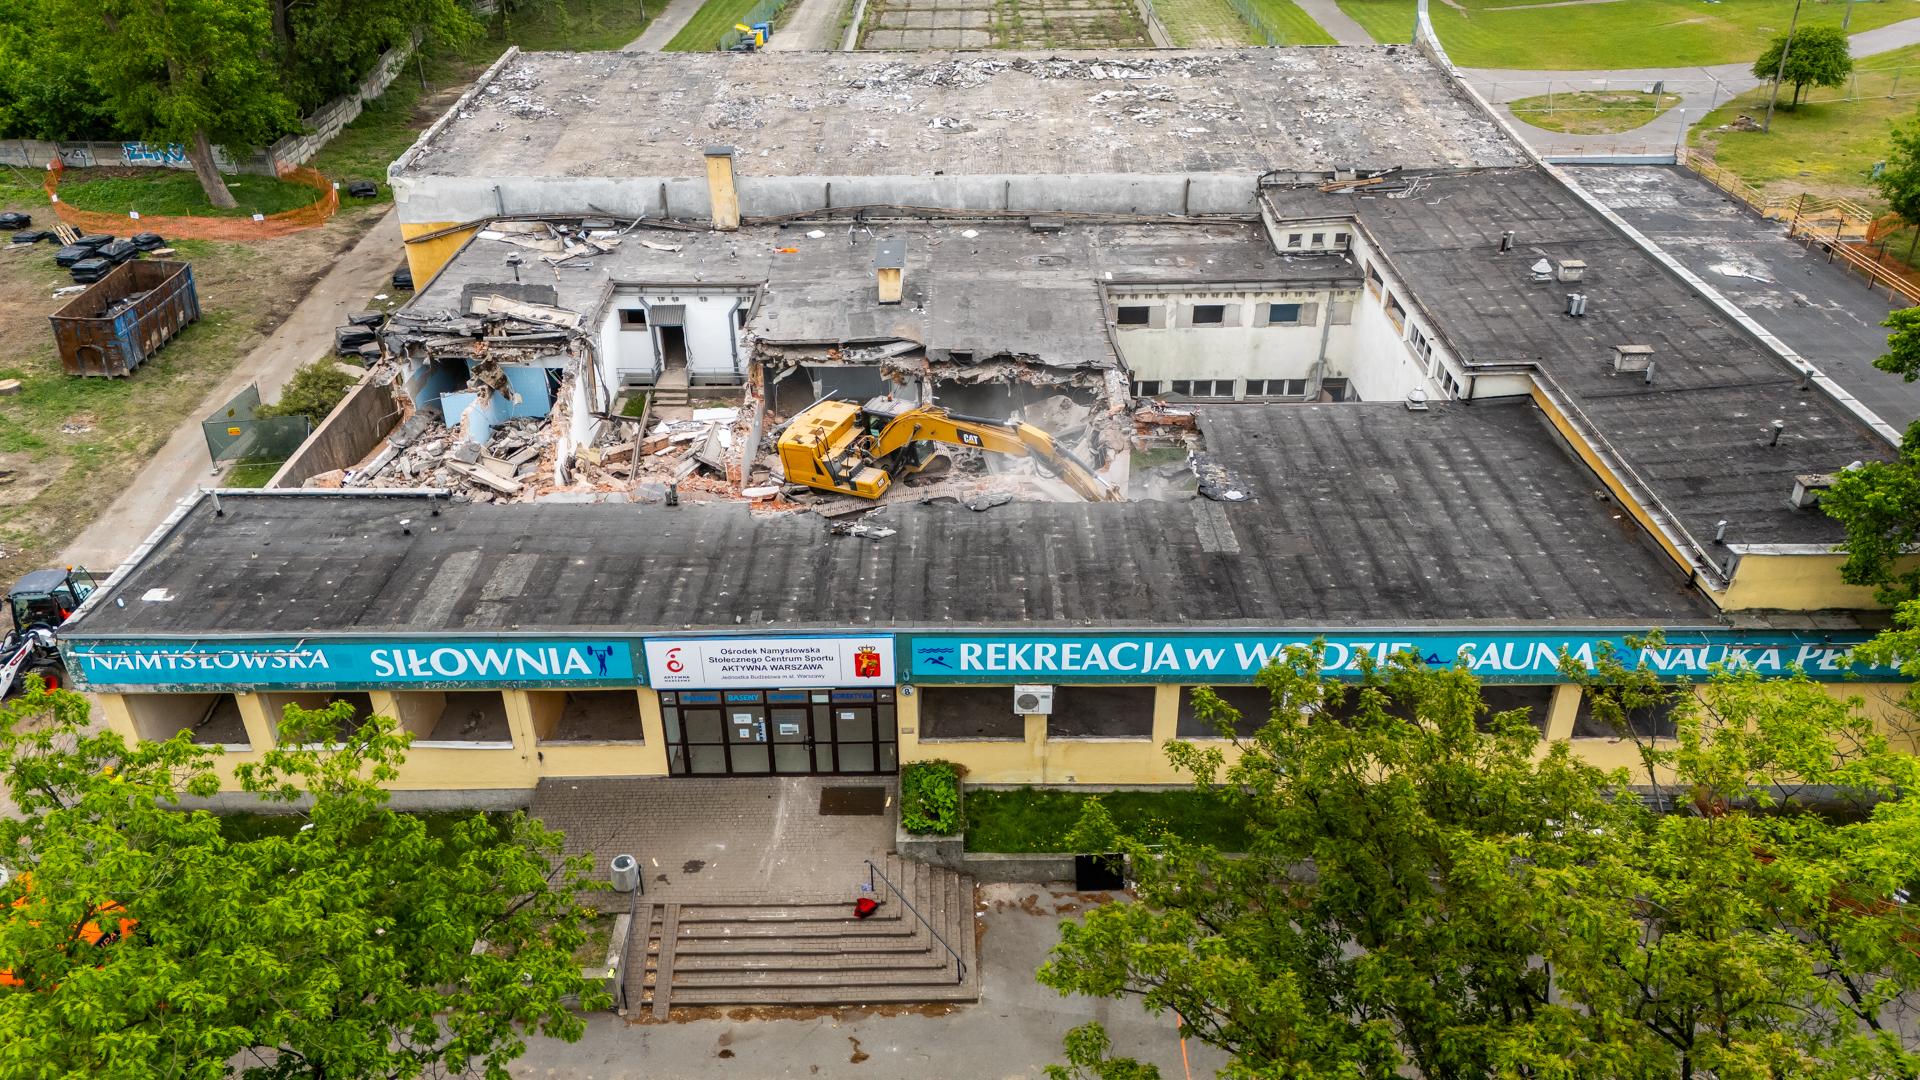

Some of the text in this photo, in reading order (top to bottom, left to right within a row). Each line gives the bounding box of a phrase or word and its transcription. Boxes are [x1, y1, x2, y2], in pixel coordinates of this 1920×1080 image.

[963, 433, 979, 445] CAT
[720, 647, 821, 656] Ośrodek Namysłowska
[960, 641, 1181, 674] REKREACJA
[1184, 648, 1226, 670] w
[1456, 642, 1595, 670] SAUNA
[1636, 642, 1781, 670] NAUKA
[89, 648, 330, 671] NAMYSŁOWSKA
[370, 647, 593, 677] SIŁOWNIA
[708, 655, 834, 664] Stołecznego Centrum Sportu
[721, 663, 824, 672] AKTYWNA WARSZAWA
[727, 694, 759, 702] BASENY
[904, 688, 911, 696] 8
